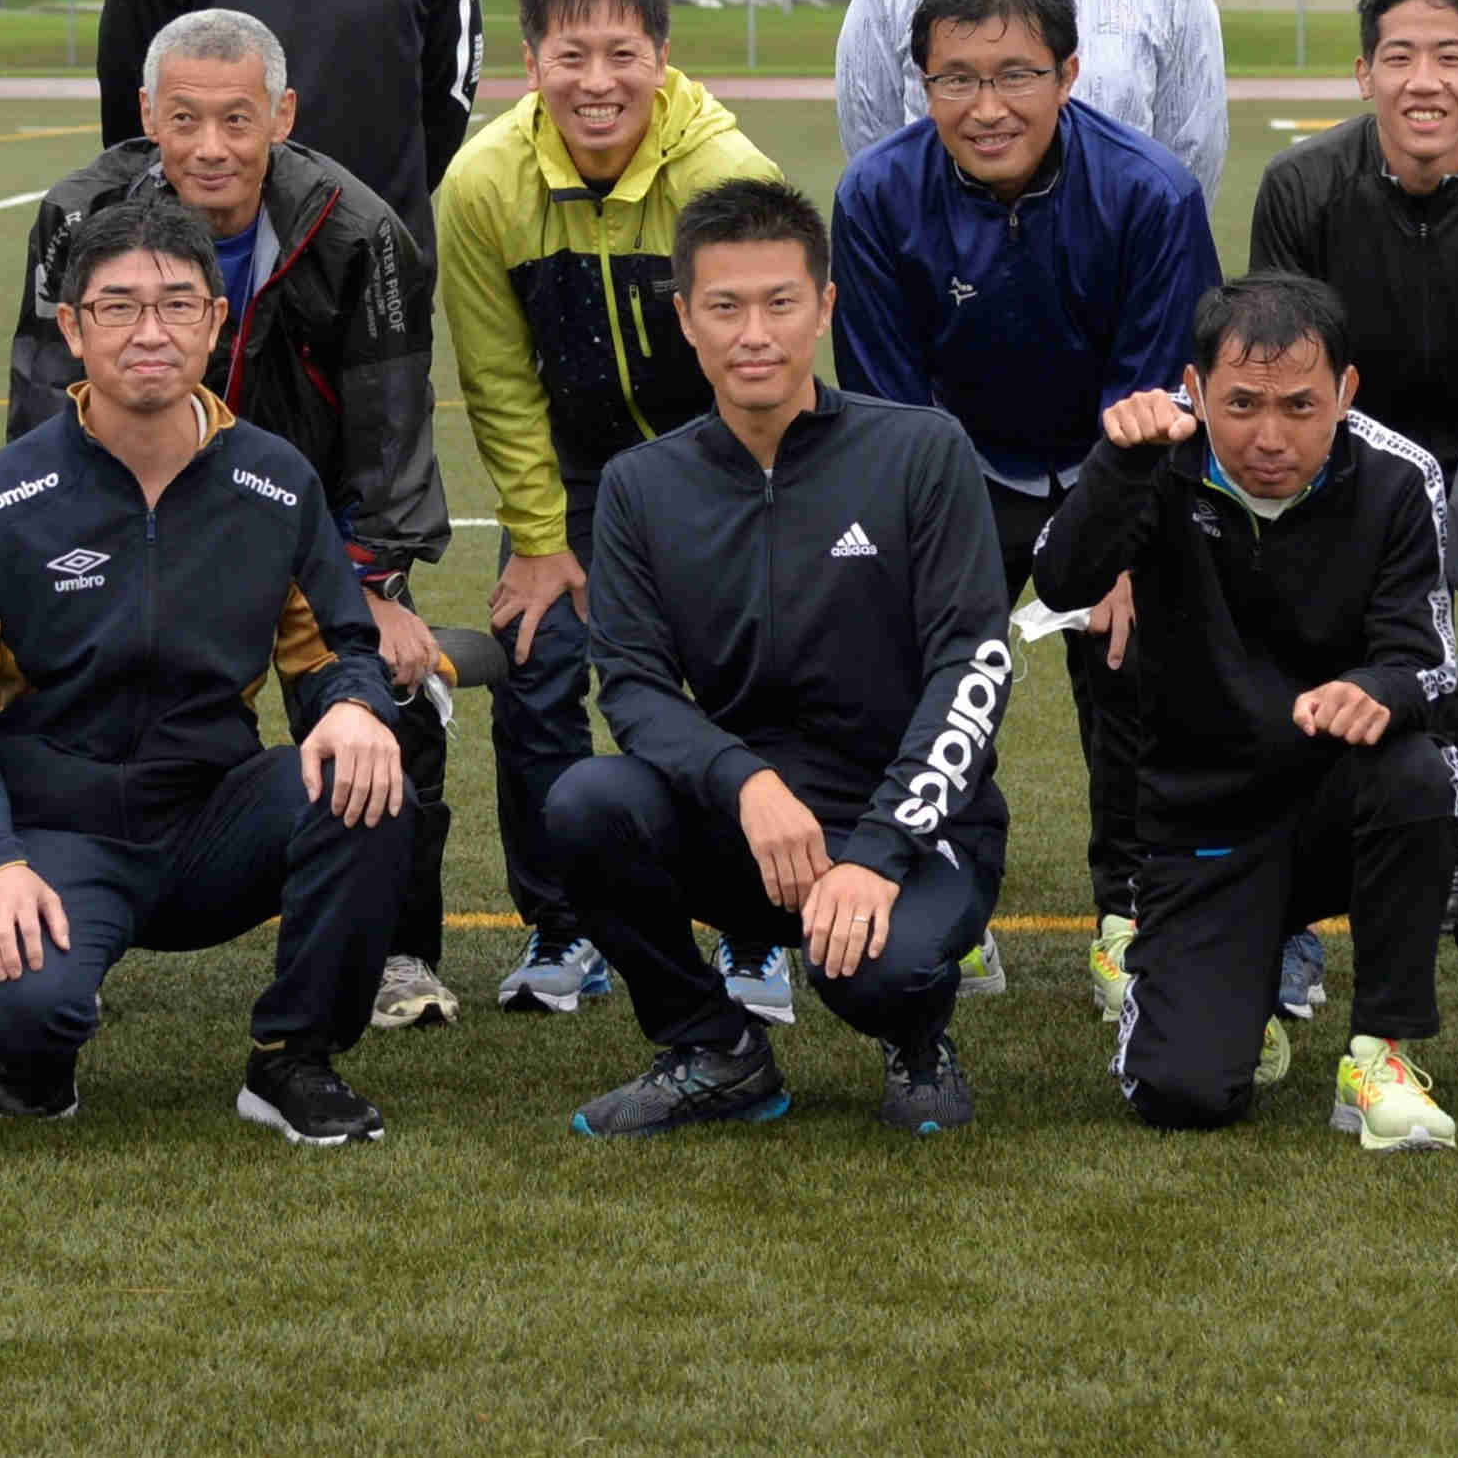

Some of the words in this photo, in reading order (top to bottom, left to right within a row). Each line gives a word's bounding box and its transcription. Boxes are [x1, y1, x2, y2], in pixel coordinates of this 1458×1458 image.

[385, 277, 406, 334] PROOF
[232, 468, 298, 507] umbro
[830, 544, 879, 557] adidas
[54, 575, 105, 593] umbro
[894, 639, 1013, 835] adidas
